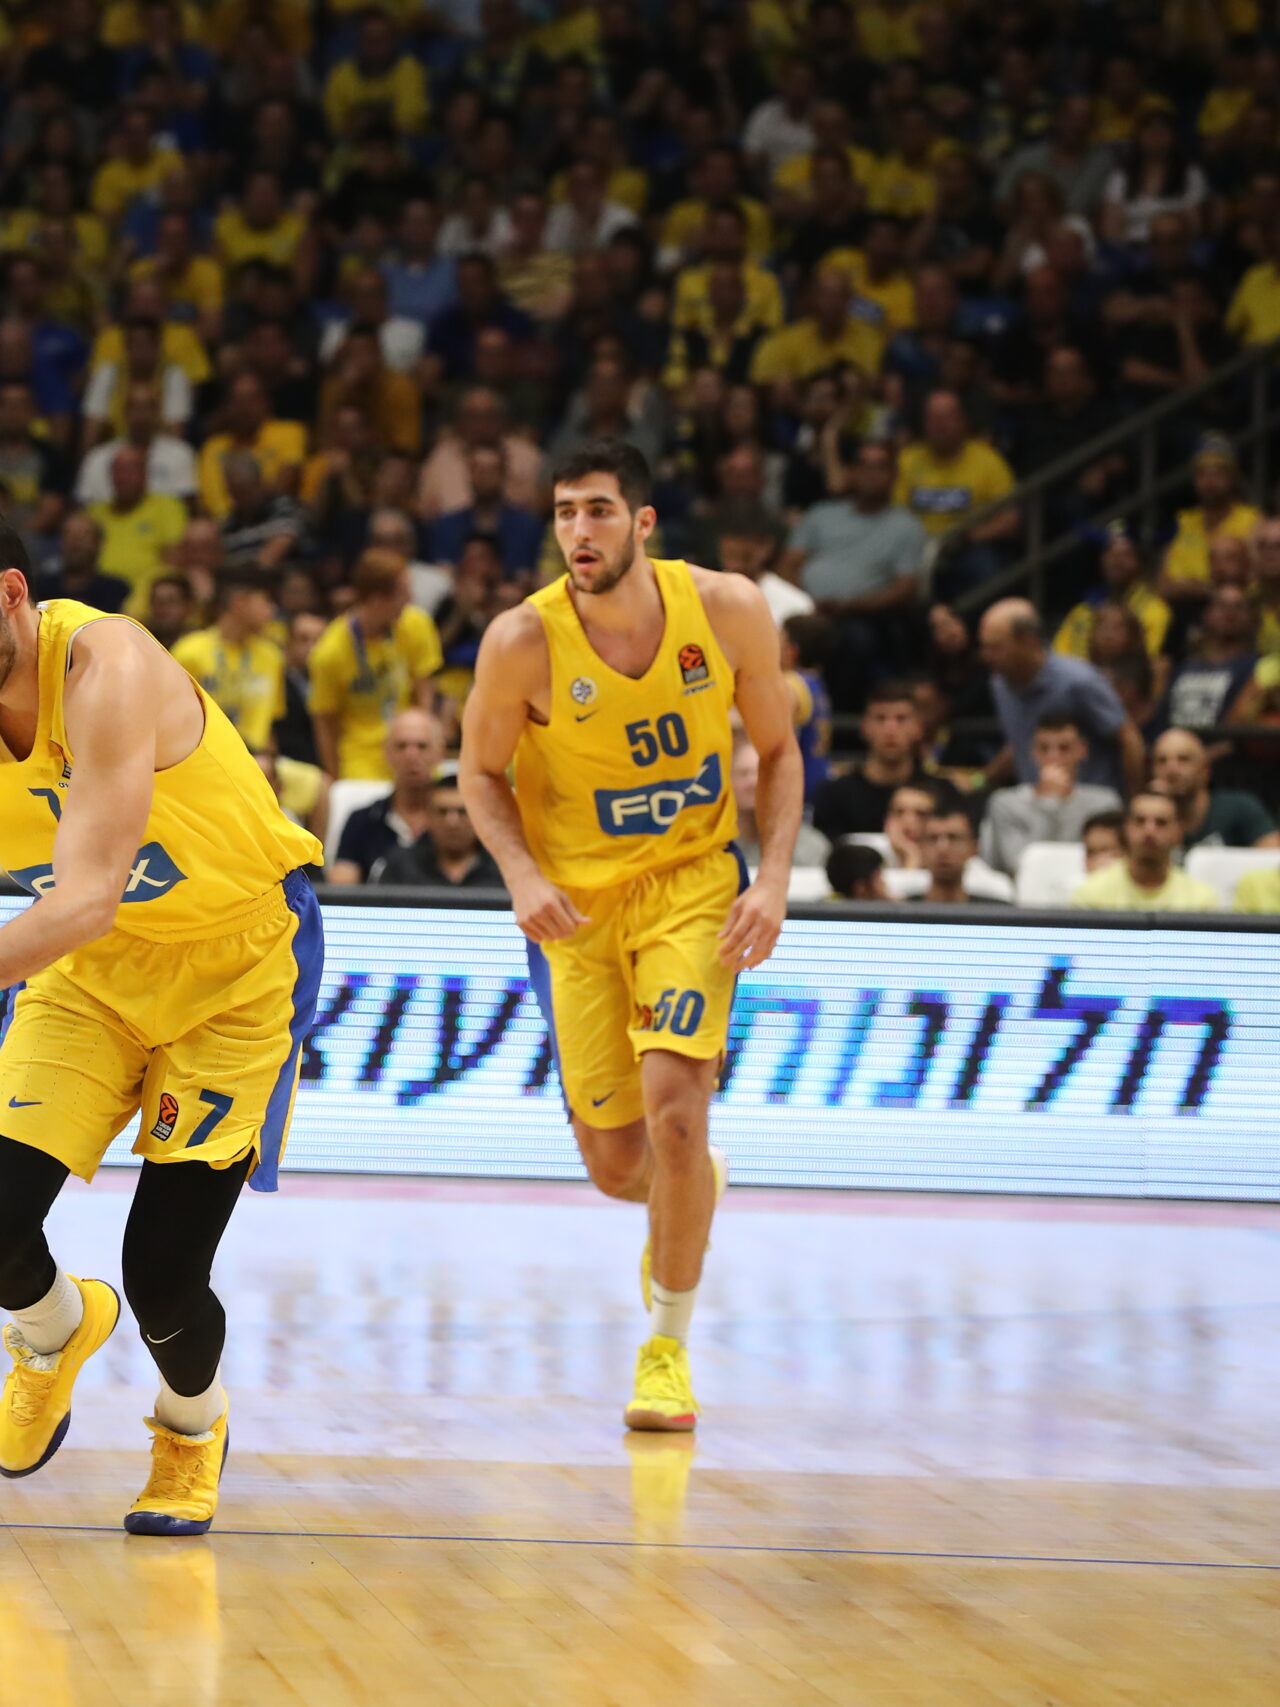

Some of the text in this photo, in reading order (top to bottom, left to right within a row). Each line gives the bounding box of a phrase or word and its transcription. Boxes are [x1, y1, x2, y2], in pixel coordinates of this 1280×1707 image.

[625, 712, 689, 767] 50
[611, 764, 712, 827] FOX
[653, 988, 706, 1037] 50
[185, 1088, 234, 1148] 7
